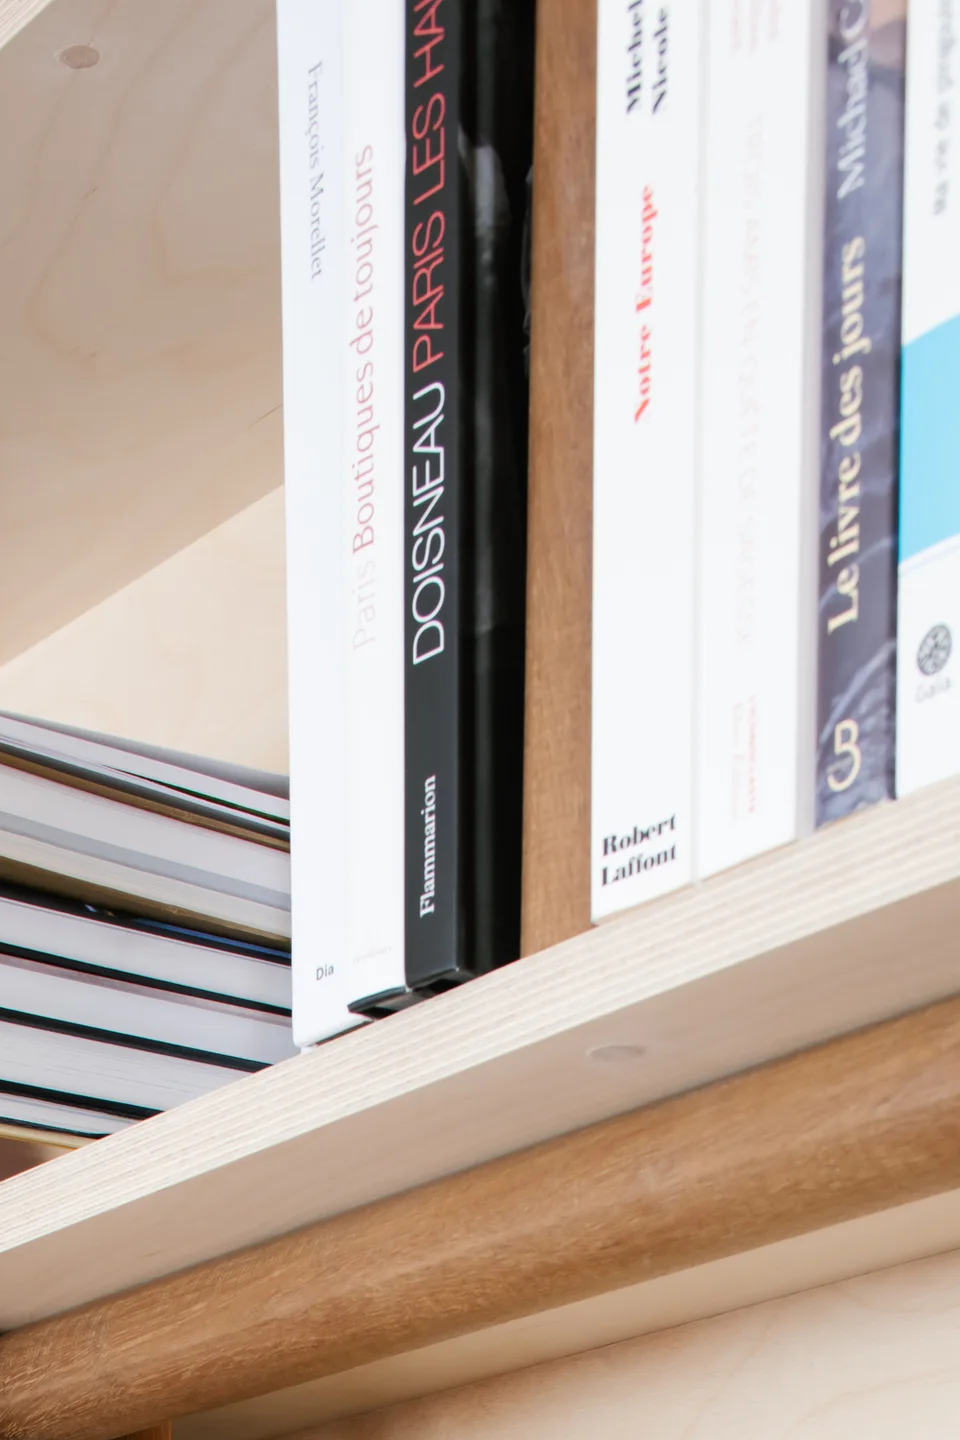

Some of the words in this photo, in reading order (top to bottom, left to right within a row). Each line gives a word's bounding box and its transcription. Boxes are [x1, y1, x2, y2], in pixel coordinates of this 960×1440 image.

[305, 58, 326, 171] François
[651, 5, 669, 115] Nicole
[412, 92, 446, 206] LES
[836, 37, 869, 200] Michael
[350, 143, 380, 304] toujours
[634, 183, 660, 314] Europe
[348, 303, 376, 357] de
[412, 210, 446, 374] PARIS
[832, 235, 873, 366] jours
[634, 322, 653, 424] Notre
[829, 365, 864, 448] des
[351, 360, 381, 556] Boutiques
[827, 450, 862, 567] livre
[411, 380, 446, 667] DOISNEAU
[351, 558, 377, 653] Paris
[826, 562, 861, 636] Le
[419, 773, 437, 919] Flammarion
[601, 843, 678, 887] Laffont
[602, 812, 677, 858] Robert
[315, 962, 335, 982] Dia
